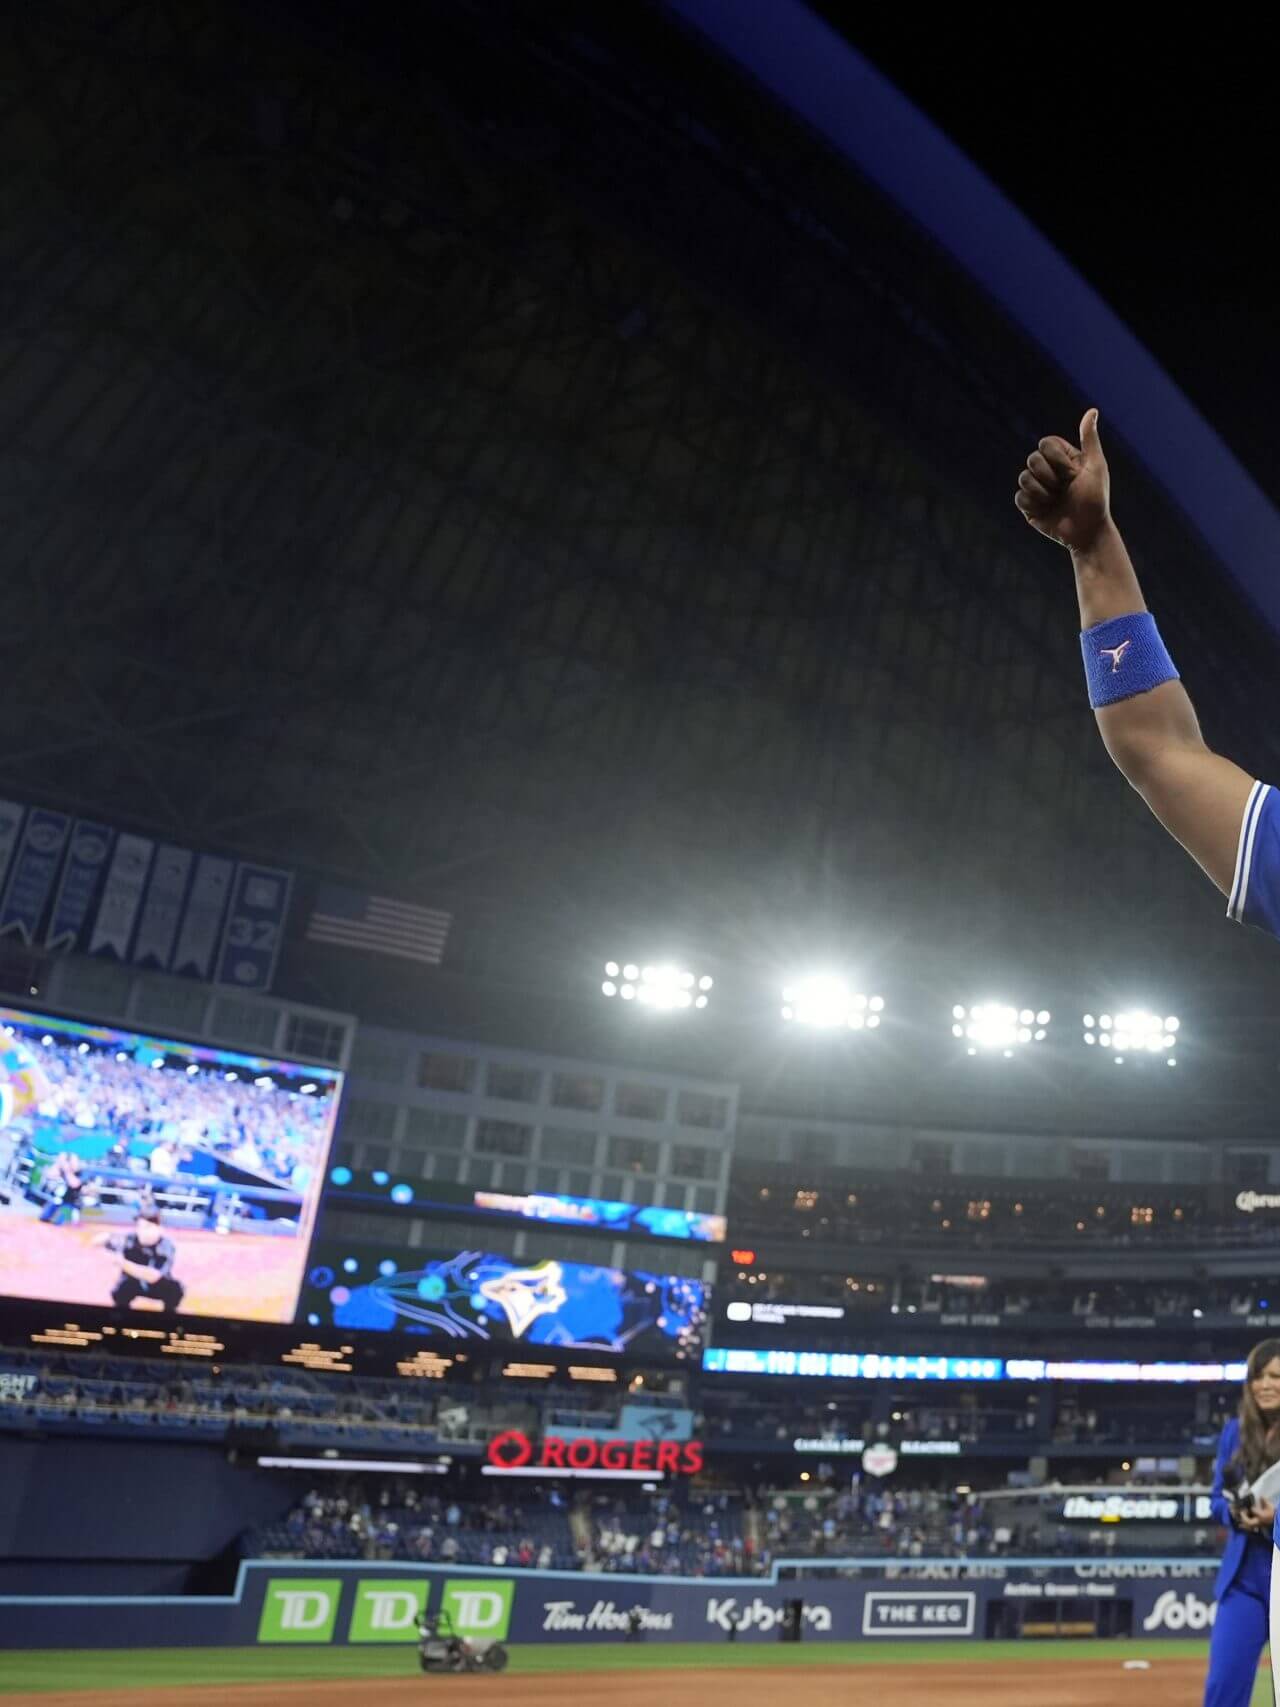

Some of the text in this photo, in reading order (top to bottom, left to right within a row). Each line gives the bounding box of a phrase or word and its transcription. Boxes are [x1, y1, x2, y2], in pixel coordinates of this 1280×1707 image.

[229, 917, 276, 951] 32
[540, 1436, 704, 1473] ROGERS
[275, 1591, 330, 1630] TD
[364, 1591, 418, 1630] TD
[451, 1591, 504, 1629] TD
[543, 1601, 585, 1631] Tim
[877, 1605, 962, 1622] THE KEG
